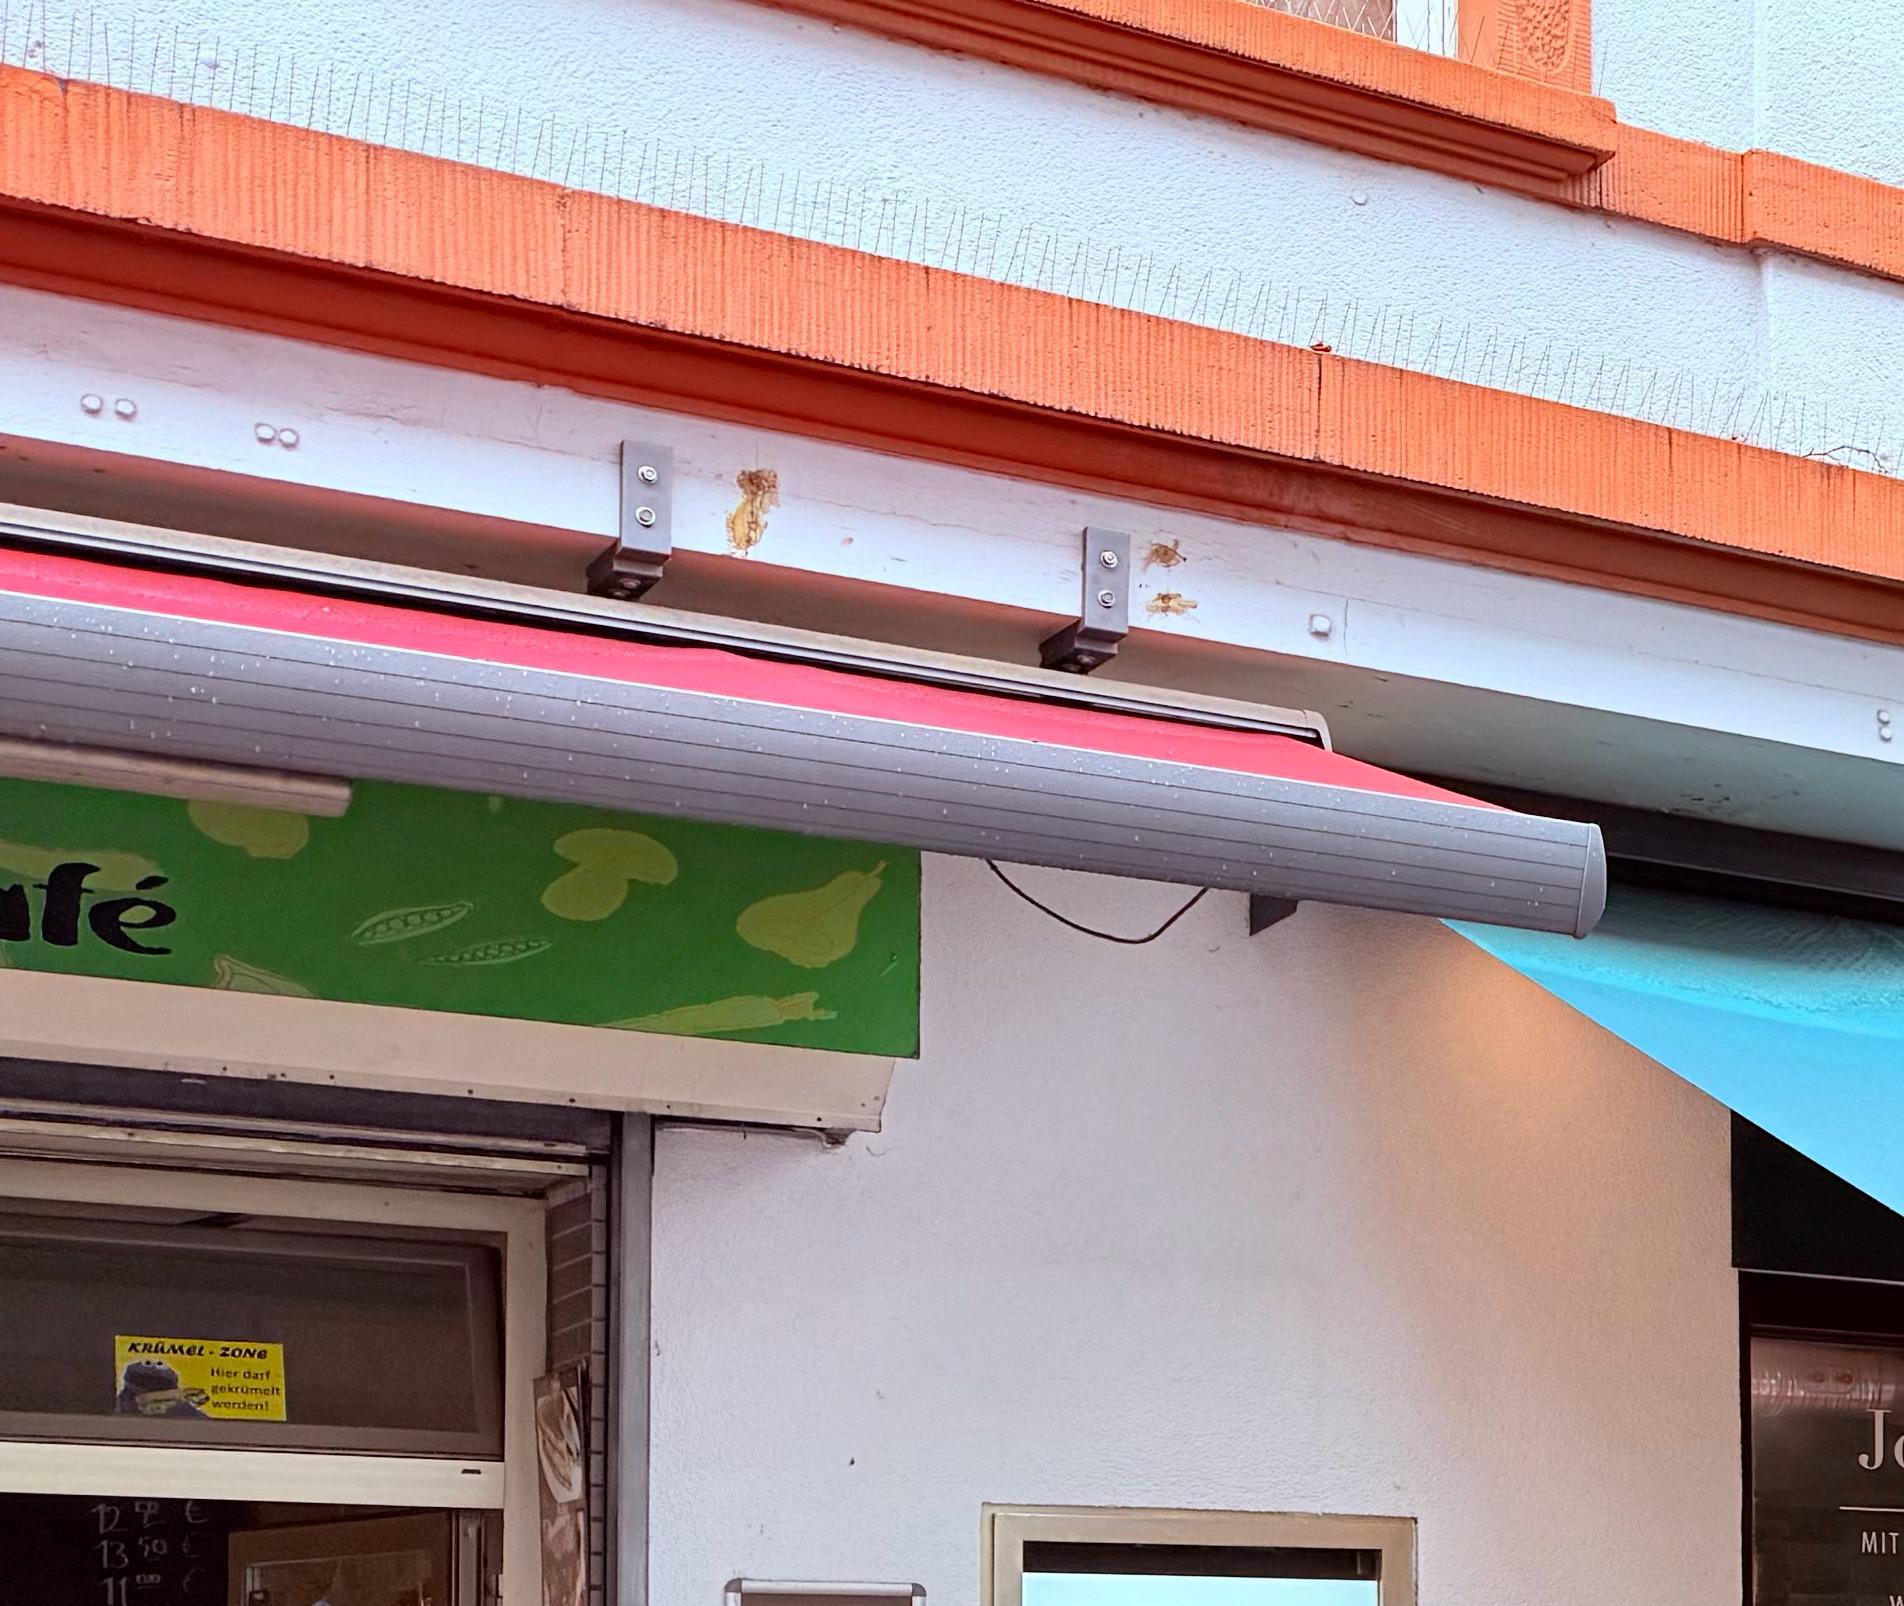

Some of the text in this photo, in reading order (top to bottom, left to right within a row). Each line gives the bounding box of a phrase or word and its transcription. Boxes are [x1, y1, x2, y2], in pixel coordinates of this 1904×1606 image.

[128, 1341, 205, 1357] KRÜMEL
[219, 1346, 268, 1360] ZONE
[211, 1368, 270, 1380] Hier darf
[211, 1384, 281, 1397] gekrümelt
[212, 1401, 269, 1411] werden!
[1861, 1531, 1899, 1554] MIT
[96, 1539, 129, 1569] 13
